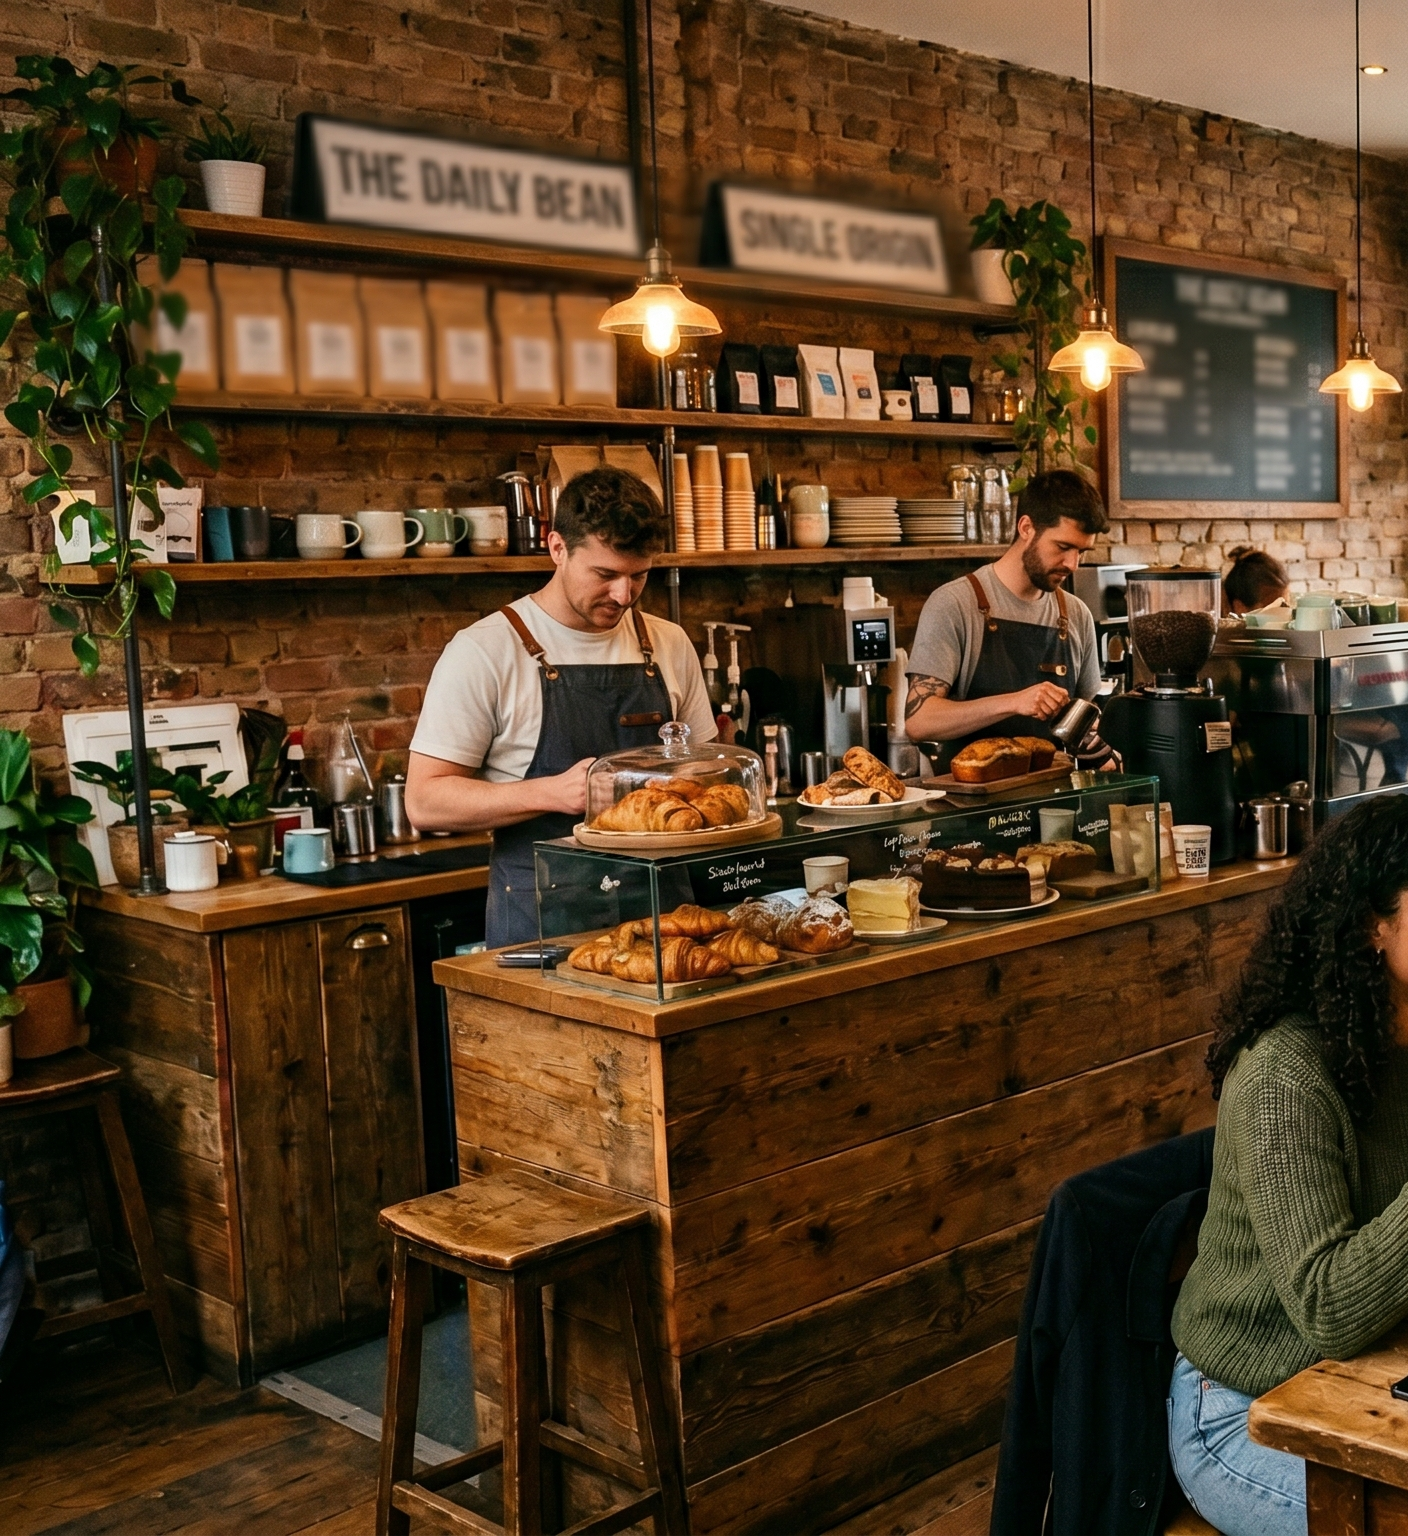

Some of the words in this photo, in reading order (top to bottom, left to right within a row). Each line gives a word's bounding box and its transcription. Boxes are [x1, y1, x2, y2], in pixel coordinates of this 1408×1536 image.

[330, 145, 409, 202] THE
[420, 158, 521, 216] DAILY
[533, 174, 625, 229] BEAN
[741, 209, 840, 261] SINGLE
